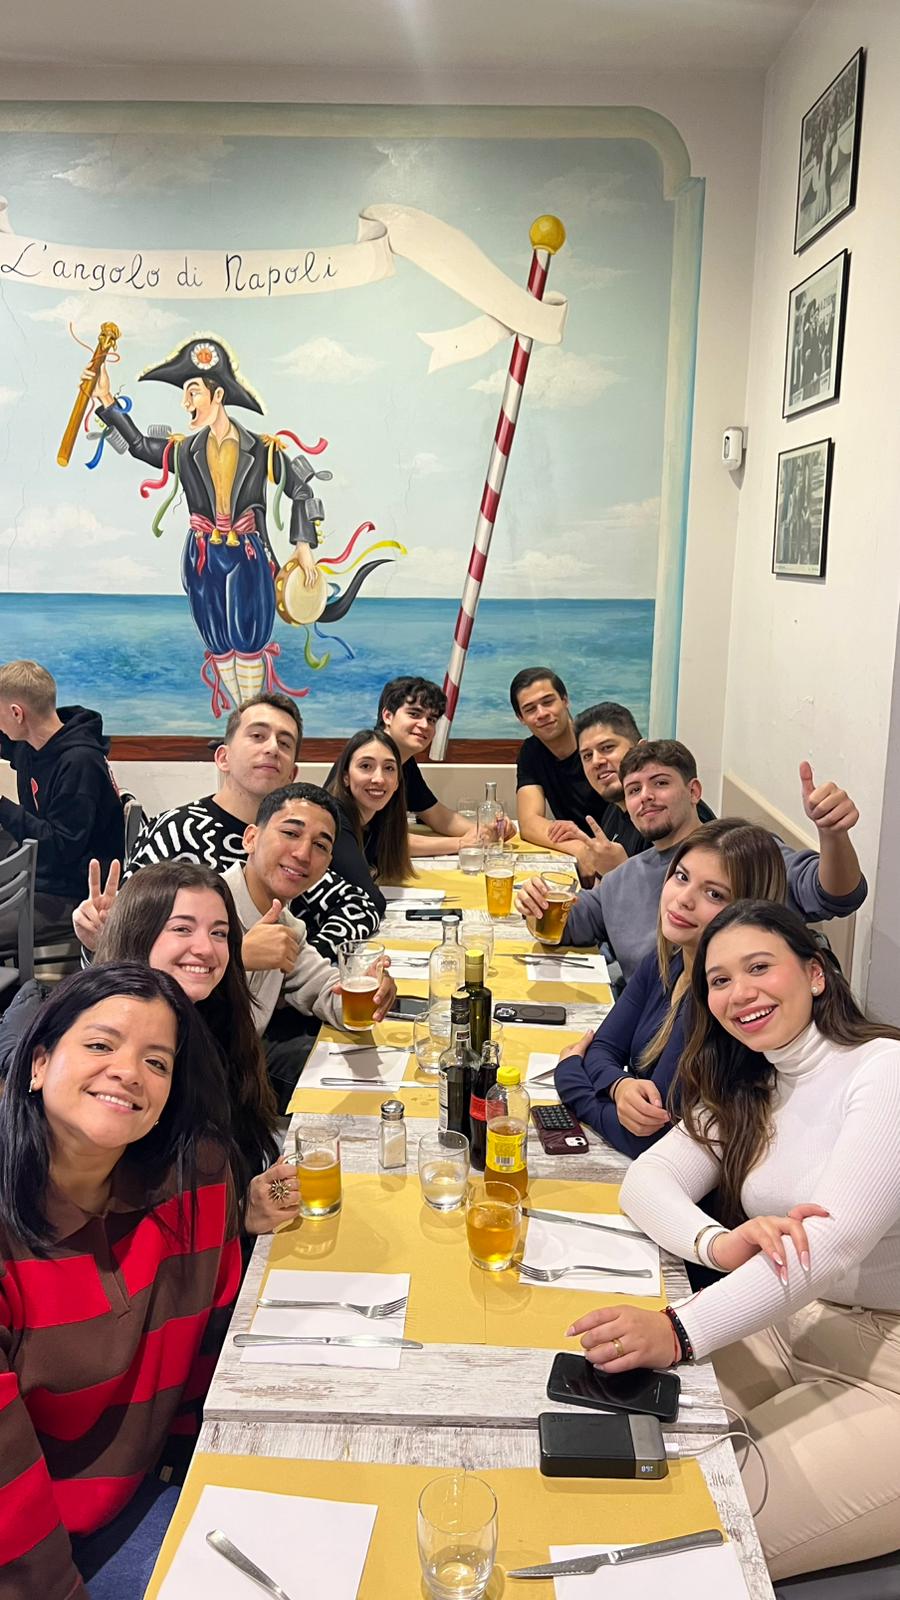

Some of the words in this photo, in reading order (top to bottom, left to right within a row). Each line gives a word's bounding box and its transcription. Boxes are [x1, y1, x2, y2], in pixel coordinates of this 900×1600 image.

[0, 242, 161, 291] L'angolo
[176, 255, 204, 287] di
[225, 251, 338, 296] Napoli
